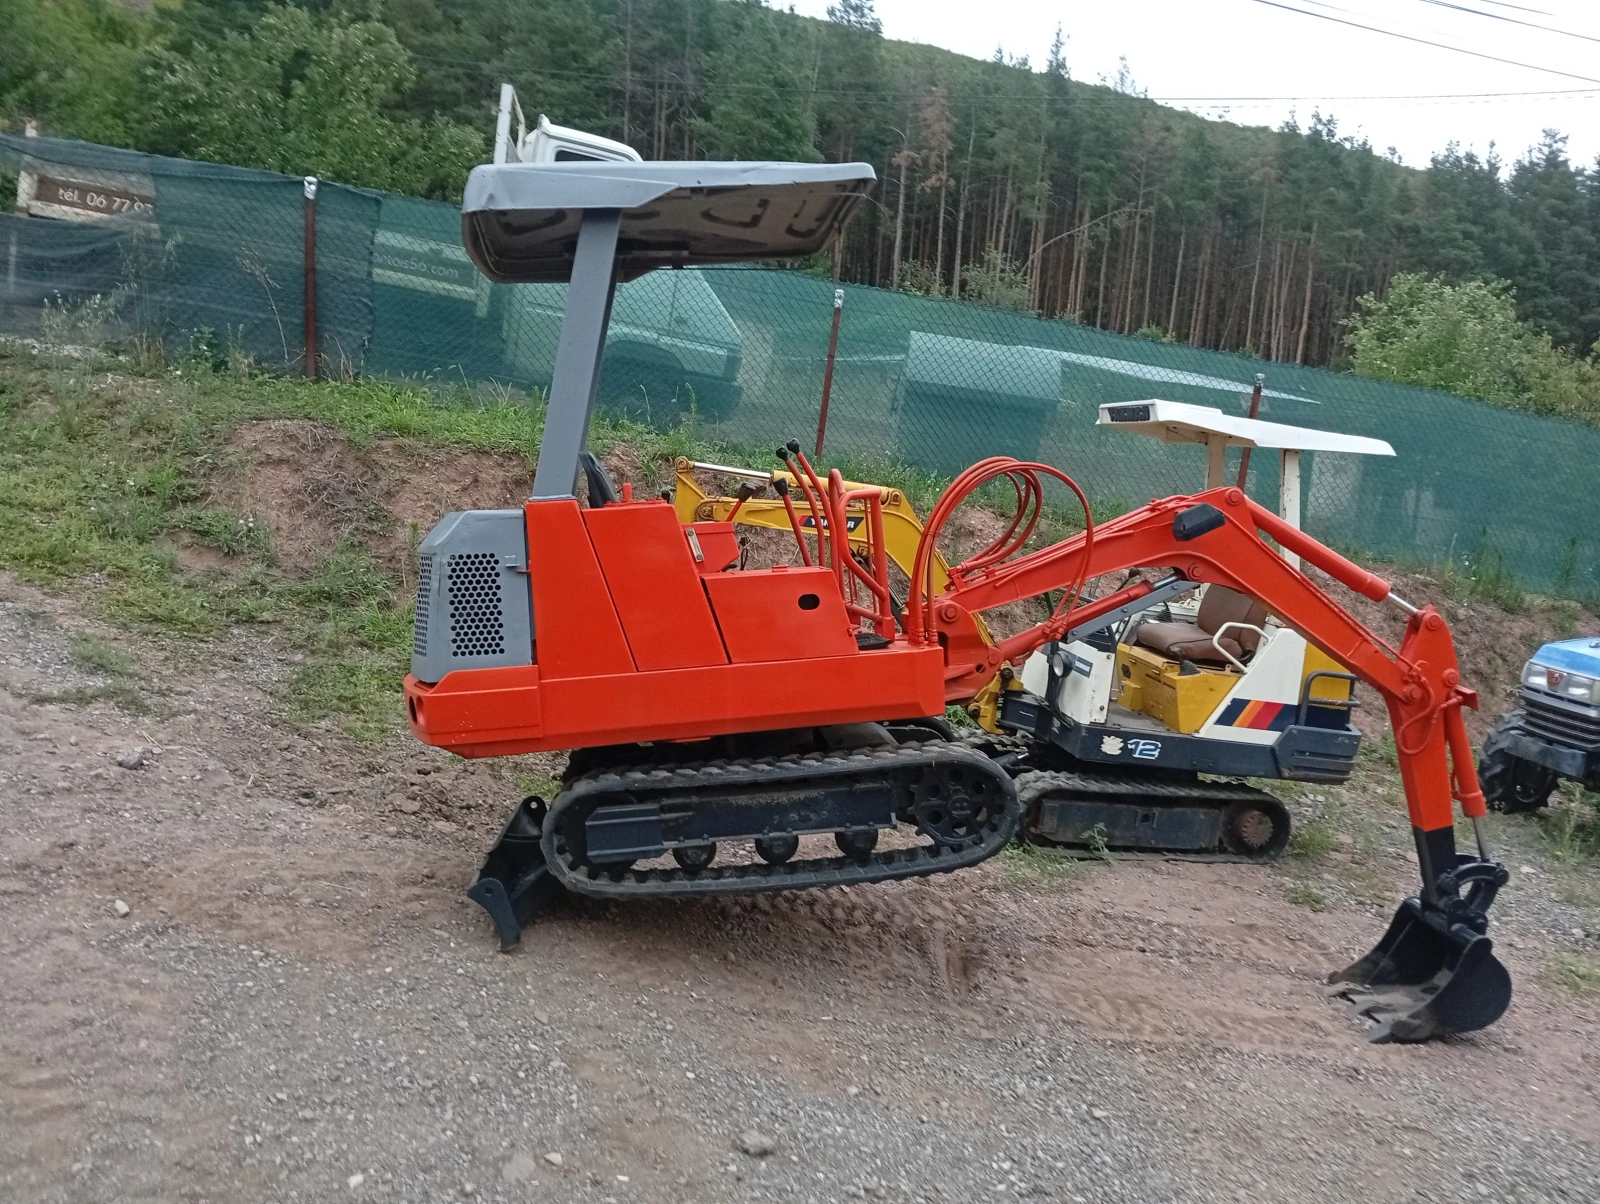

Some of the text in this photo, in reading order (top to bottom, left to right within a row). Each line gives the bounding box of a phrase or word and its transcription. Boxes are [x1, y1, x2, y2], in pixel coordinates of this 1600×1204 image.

[86, 192, 107, 208] 06
[113, 197, 131, 212] 77
[1127, 739, 1162, 760] 12
